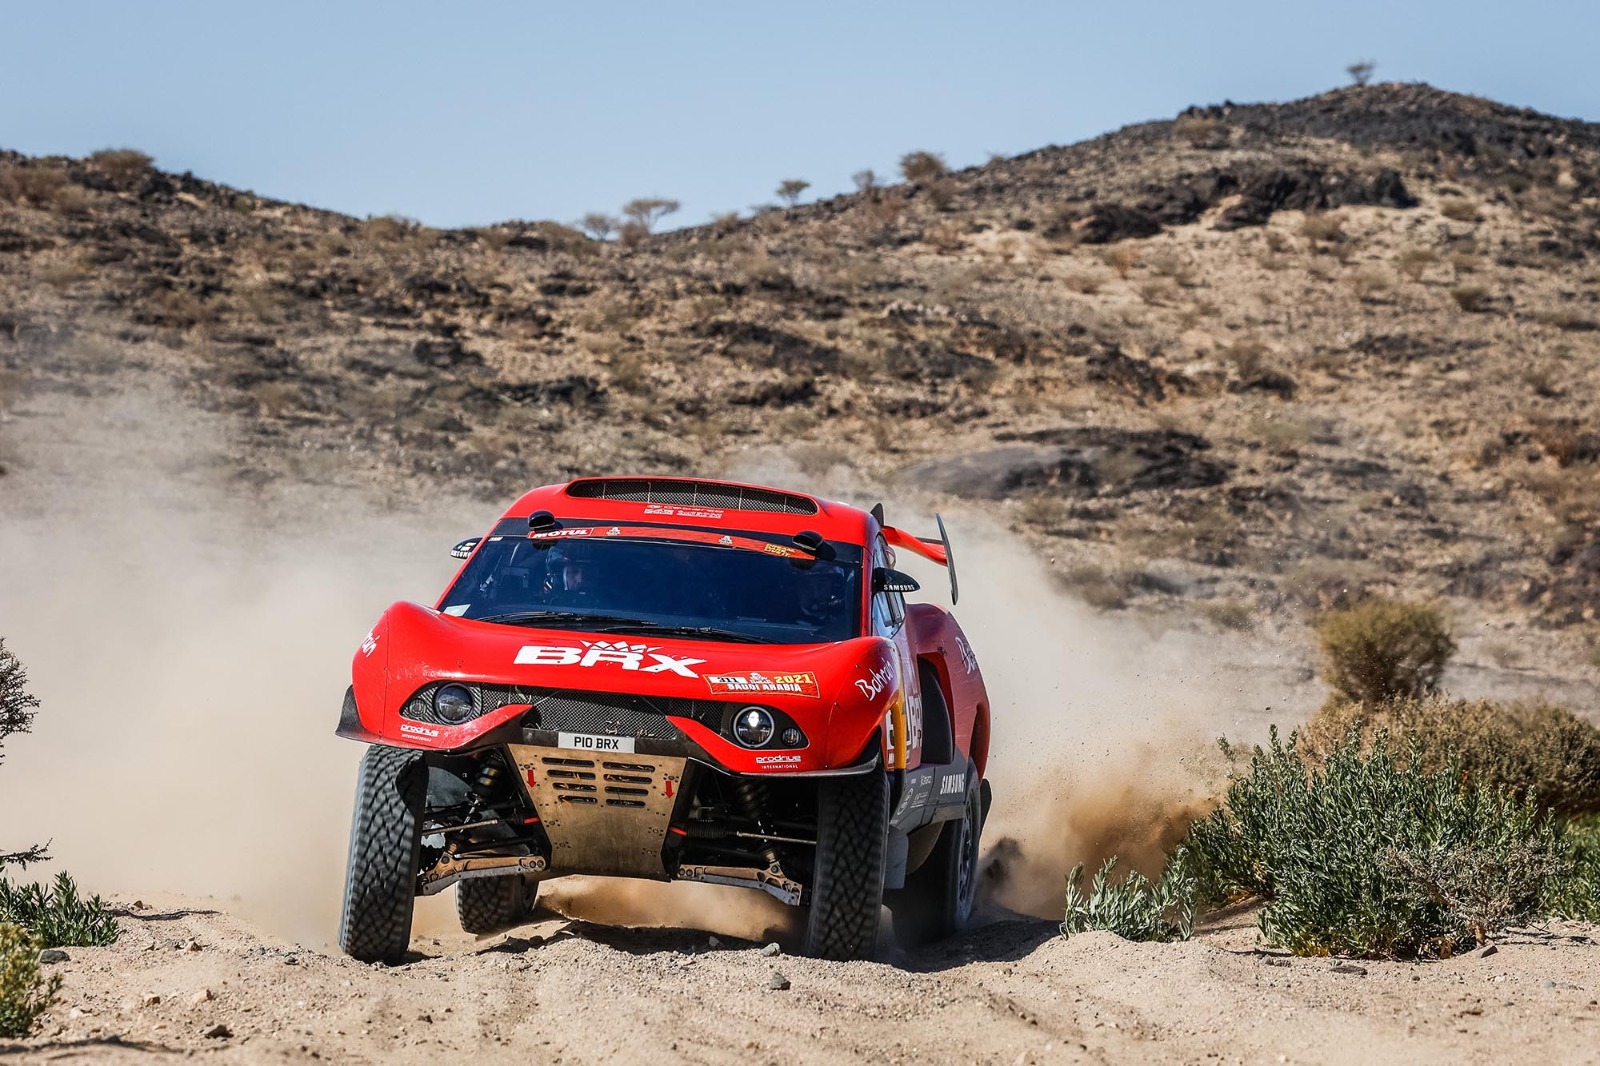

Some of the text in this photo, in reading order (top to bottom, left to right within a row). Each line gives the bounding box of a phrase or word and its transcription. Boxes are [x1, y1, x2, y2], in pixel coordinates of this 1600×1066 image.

[532, 529, 589, 539] MOTUL
[513, 645, 708, 679] BRX
[773, 673, 814, 685] 2021
[727, 683, 803, 692] SAUDI ARABIA
[595, 738, 619, 750] BRX
